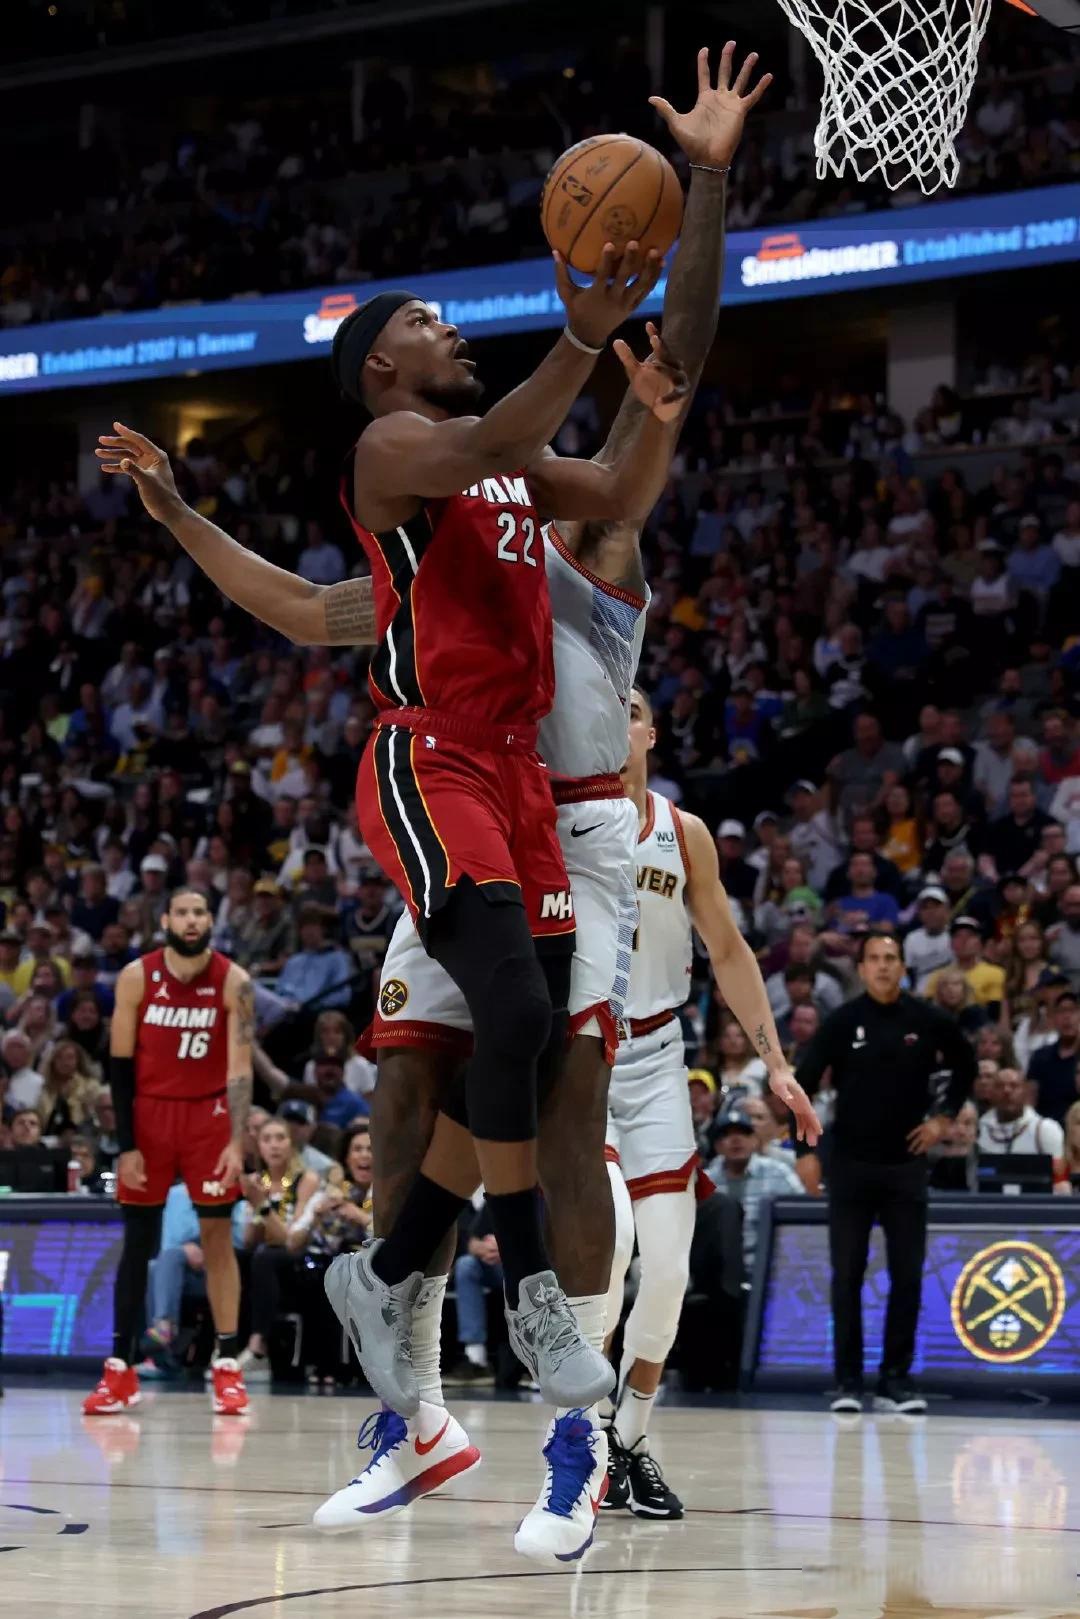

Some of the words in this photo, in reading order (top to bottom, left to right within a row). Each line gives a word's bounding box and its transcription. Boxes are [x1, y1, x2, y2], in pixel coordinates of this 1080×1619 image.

[903, 226, 1023, 266] Established
[1026, 216, 1077, 249] 2007
[42, 341, 134, 375] Established
[178, 336, 195, 358] in
[197, 332, 257, 356] Denver
[497, 511, 537, 568] 22
[655, 831, 675, 843] WU
[143, 1003, 217, 1029] MIAMI
[177, 1031, 210, 1060] 16
